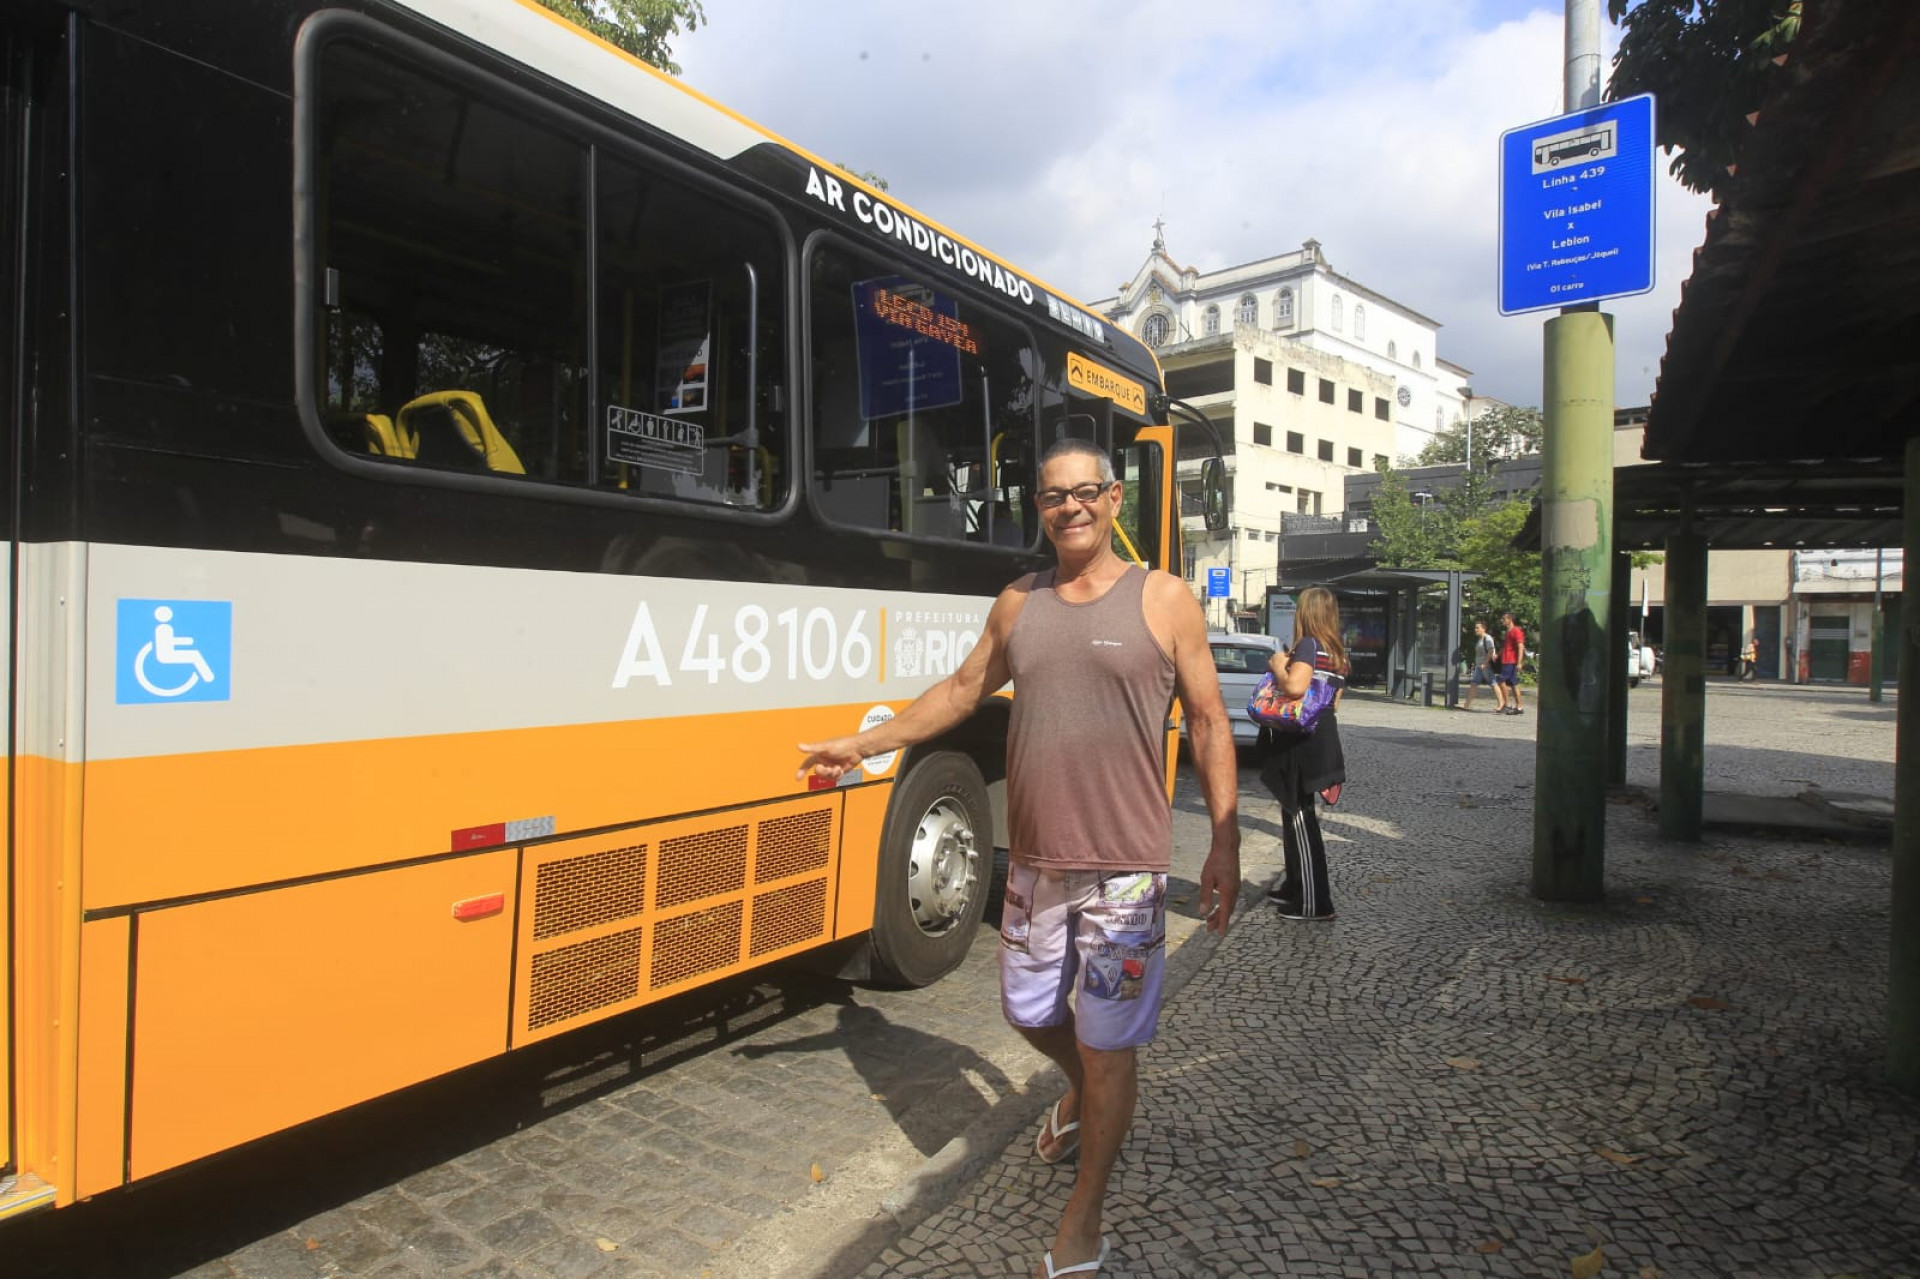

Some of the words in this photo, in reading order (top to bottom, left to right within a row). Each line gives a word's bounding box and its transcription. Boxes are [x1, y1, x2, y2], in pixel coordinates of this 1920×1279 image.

[1542, 174, 1576, 189] Linha
[1580, 165, 1606, 180] 439
[1543, 208, 1566, 220] Vila
[1568, 199, 1602, 215] Isabel
[805, 166, 846, 213] AR
[852, 191, 1034, 306] CONDICIONADO
[1551, 235, 1590, 250] Leblon
[1086, 369, 1131, 401] EMBARQUE
[895, 610, 980, 624] PREFEITURA
